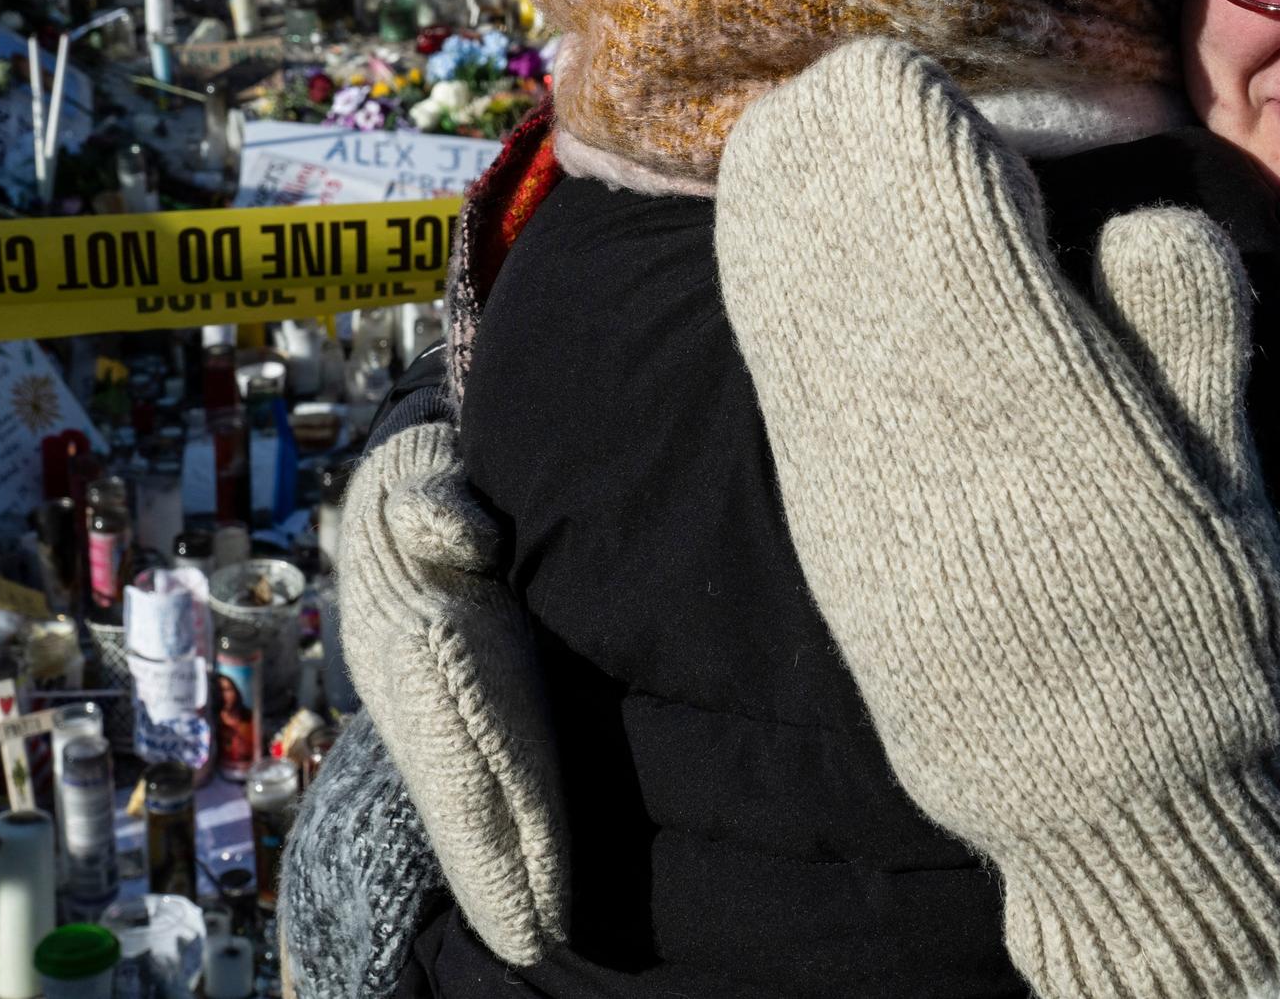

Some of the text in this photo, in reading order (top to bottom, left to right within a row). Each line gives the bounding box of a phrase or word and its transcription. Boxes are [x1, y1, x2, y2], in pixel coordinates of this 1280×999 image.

[325, 136, 417, 170] ALEX
[57, 229, 158, 291] NOT
[178, 224, 242, 283] DO
[260, 221, 368, 279] LINE
[386, 215, 459, 272] ICE
